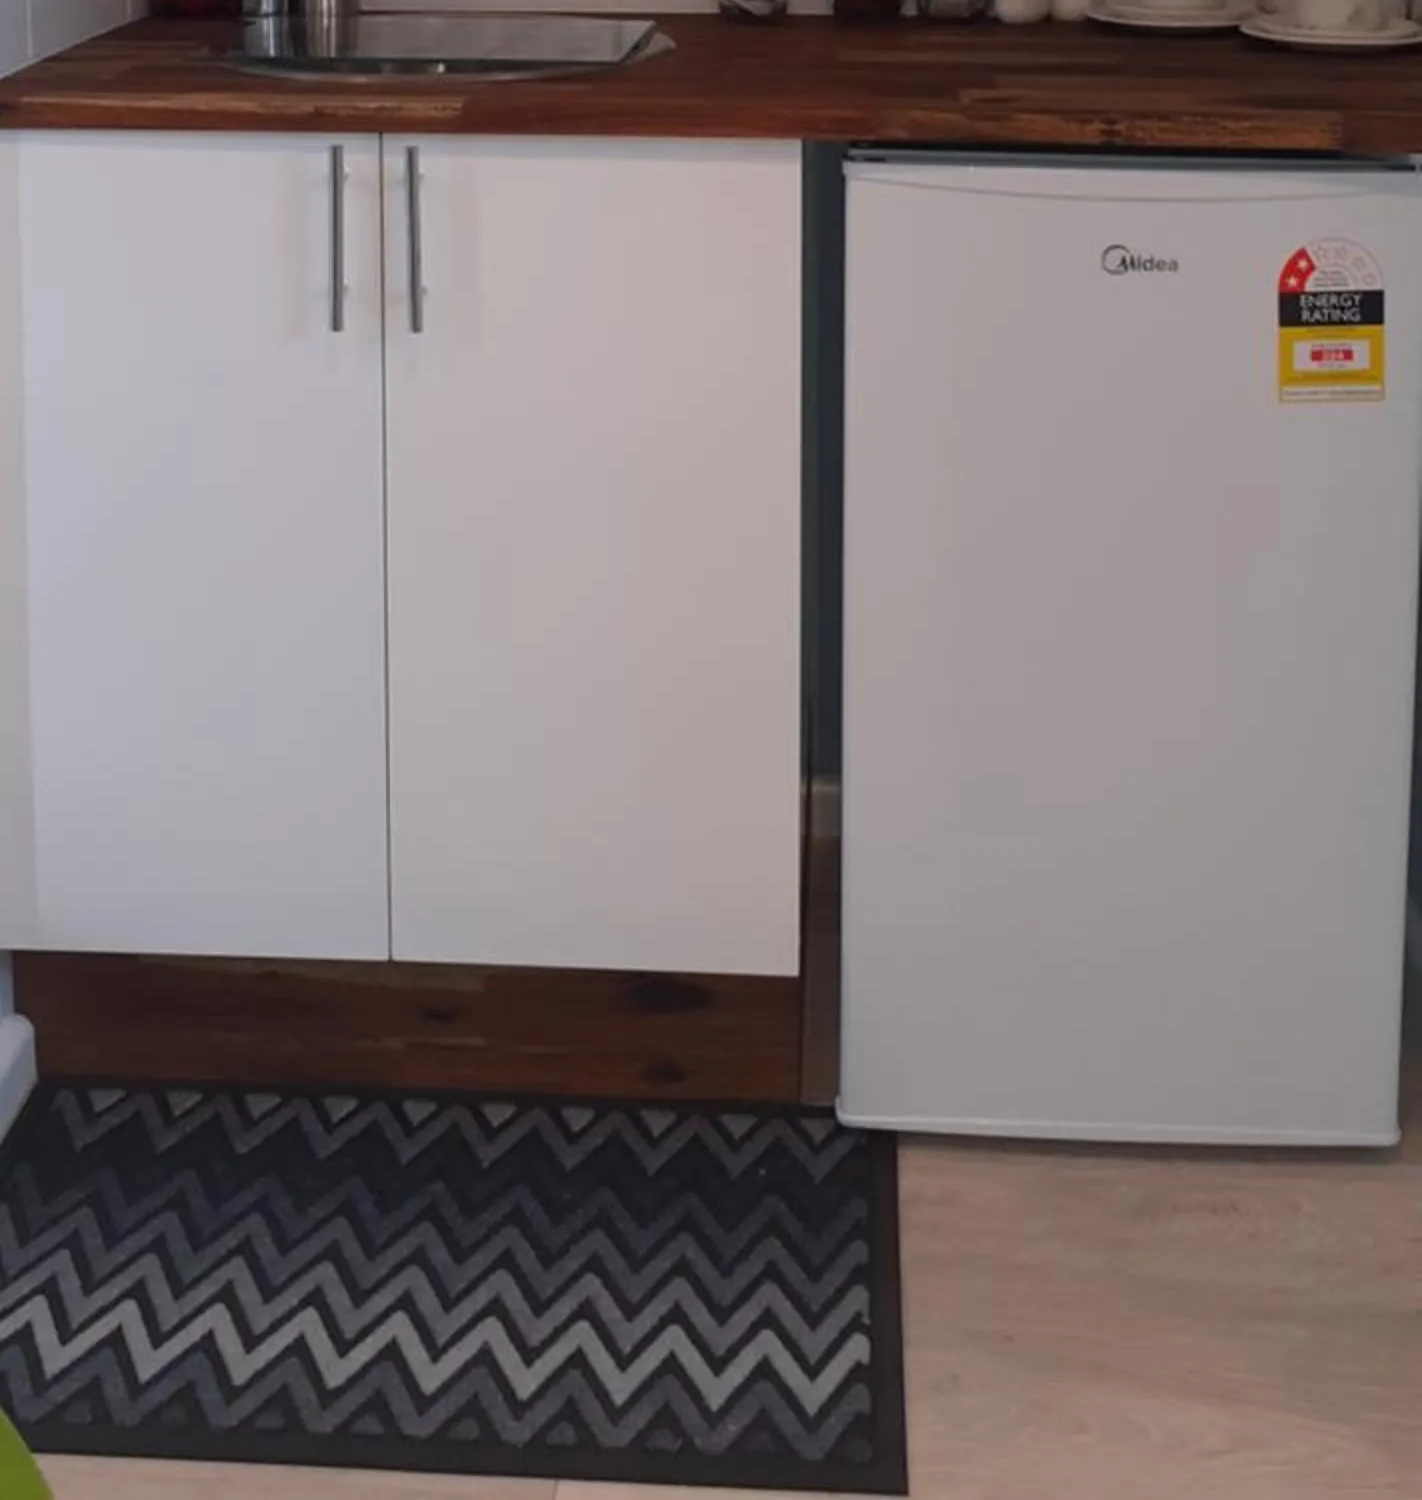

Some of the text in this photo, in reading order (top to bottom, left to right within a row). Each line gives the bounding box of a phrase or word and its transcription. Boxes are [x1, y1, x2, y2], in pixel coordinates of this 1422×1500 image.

[1101, 244, 1179, 275] Midea
[1299, 293, 1362, 308] ENERGY
[1301, 308, 1361, 323] RATING
